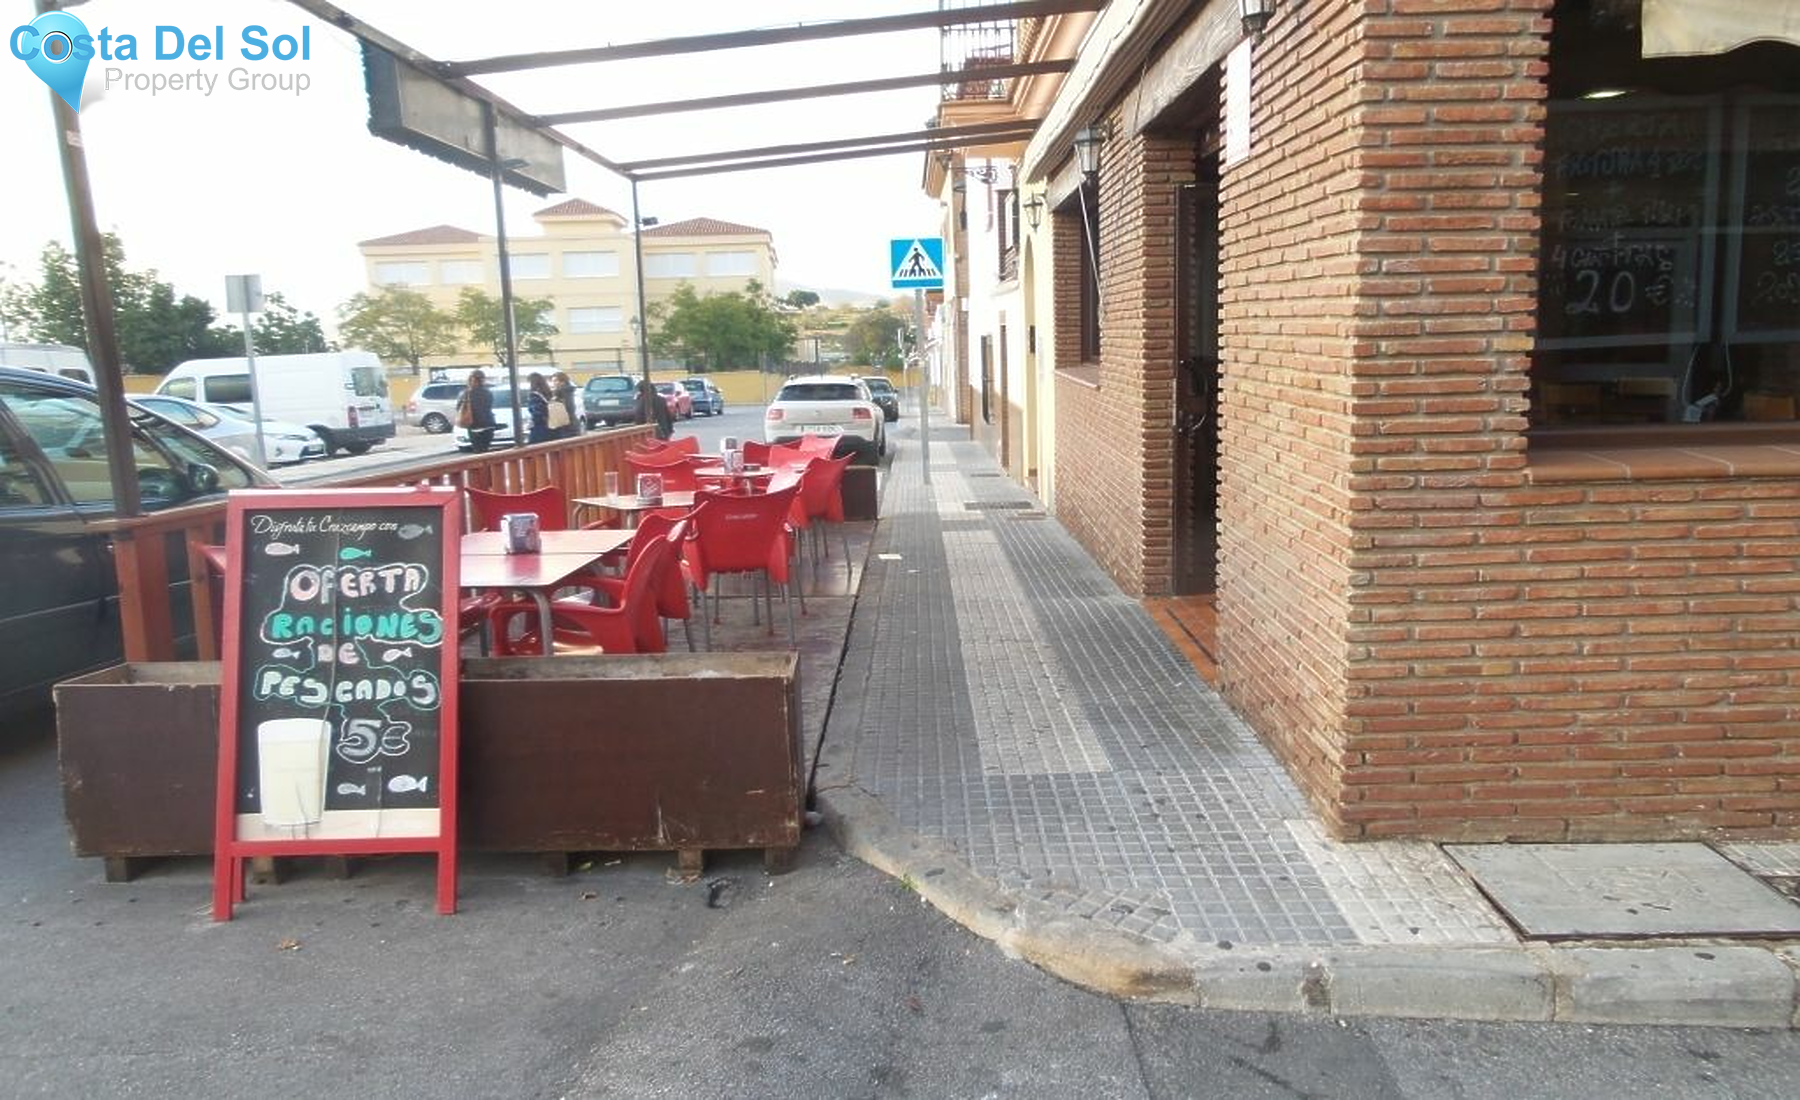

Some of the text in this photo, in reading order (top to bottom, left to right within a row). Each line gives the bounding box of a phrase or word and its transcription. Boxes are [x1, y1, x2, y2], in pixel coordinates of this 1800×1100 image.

[1565, 269, 1636, 314] 20
[319, 515, 375, 540] Cruzcampo
[378, 522, 397, 531] con
[290, 567, 421, 604] OFERTA
[318, 643, 360, 665] DE
[261, 671, 436, 704] PESCADOS
